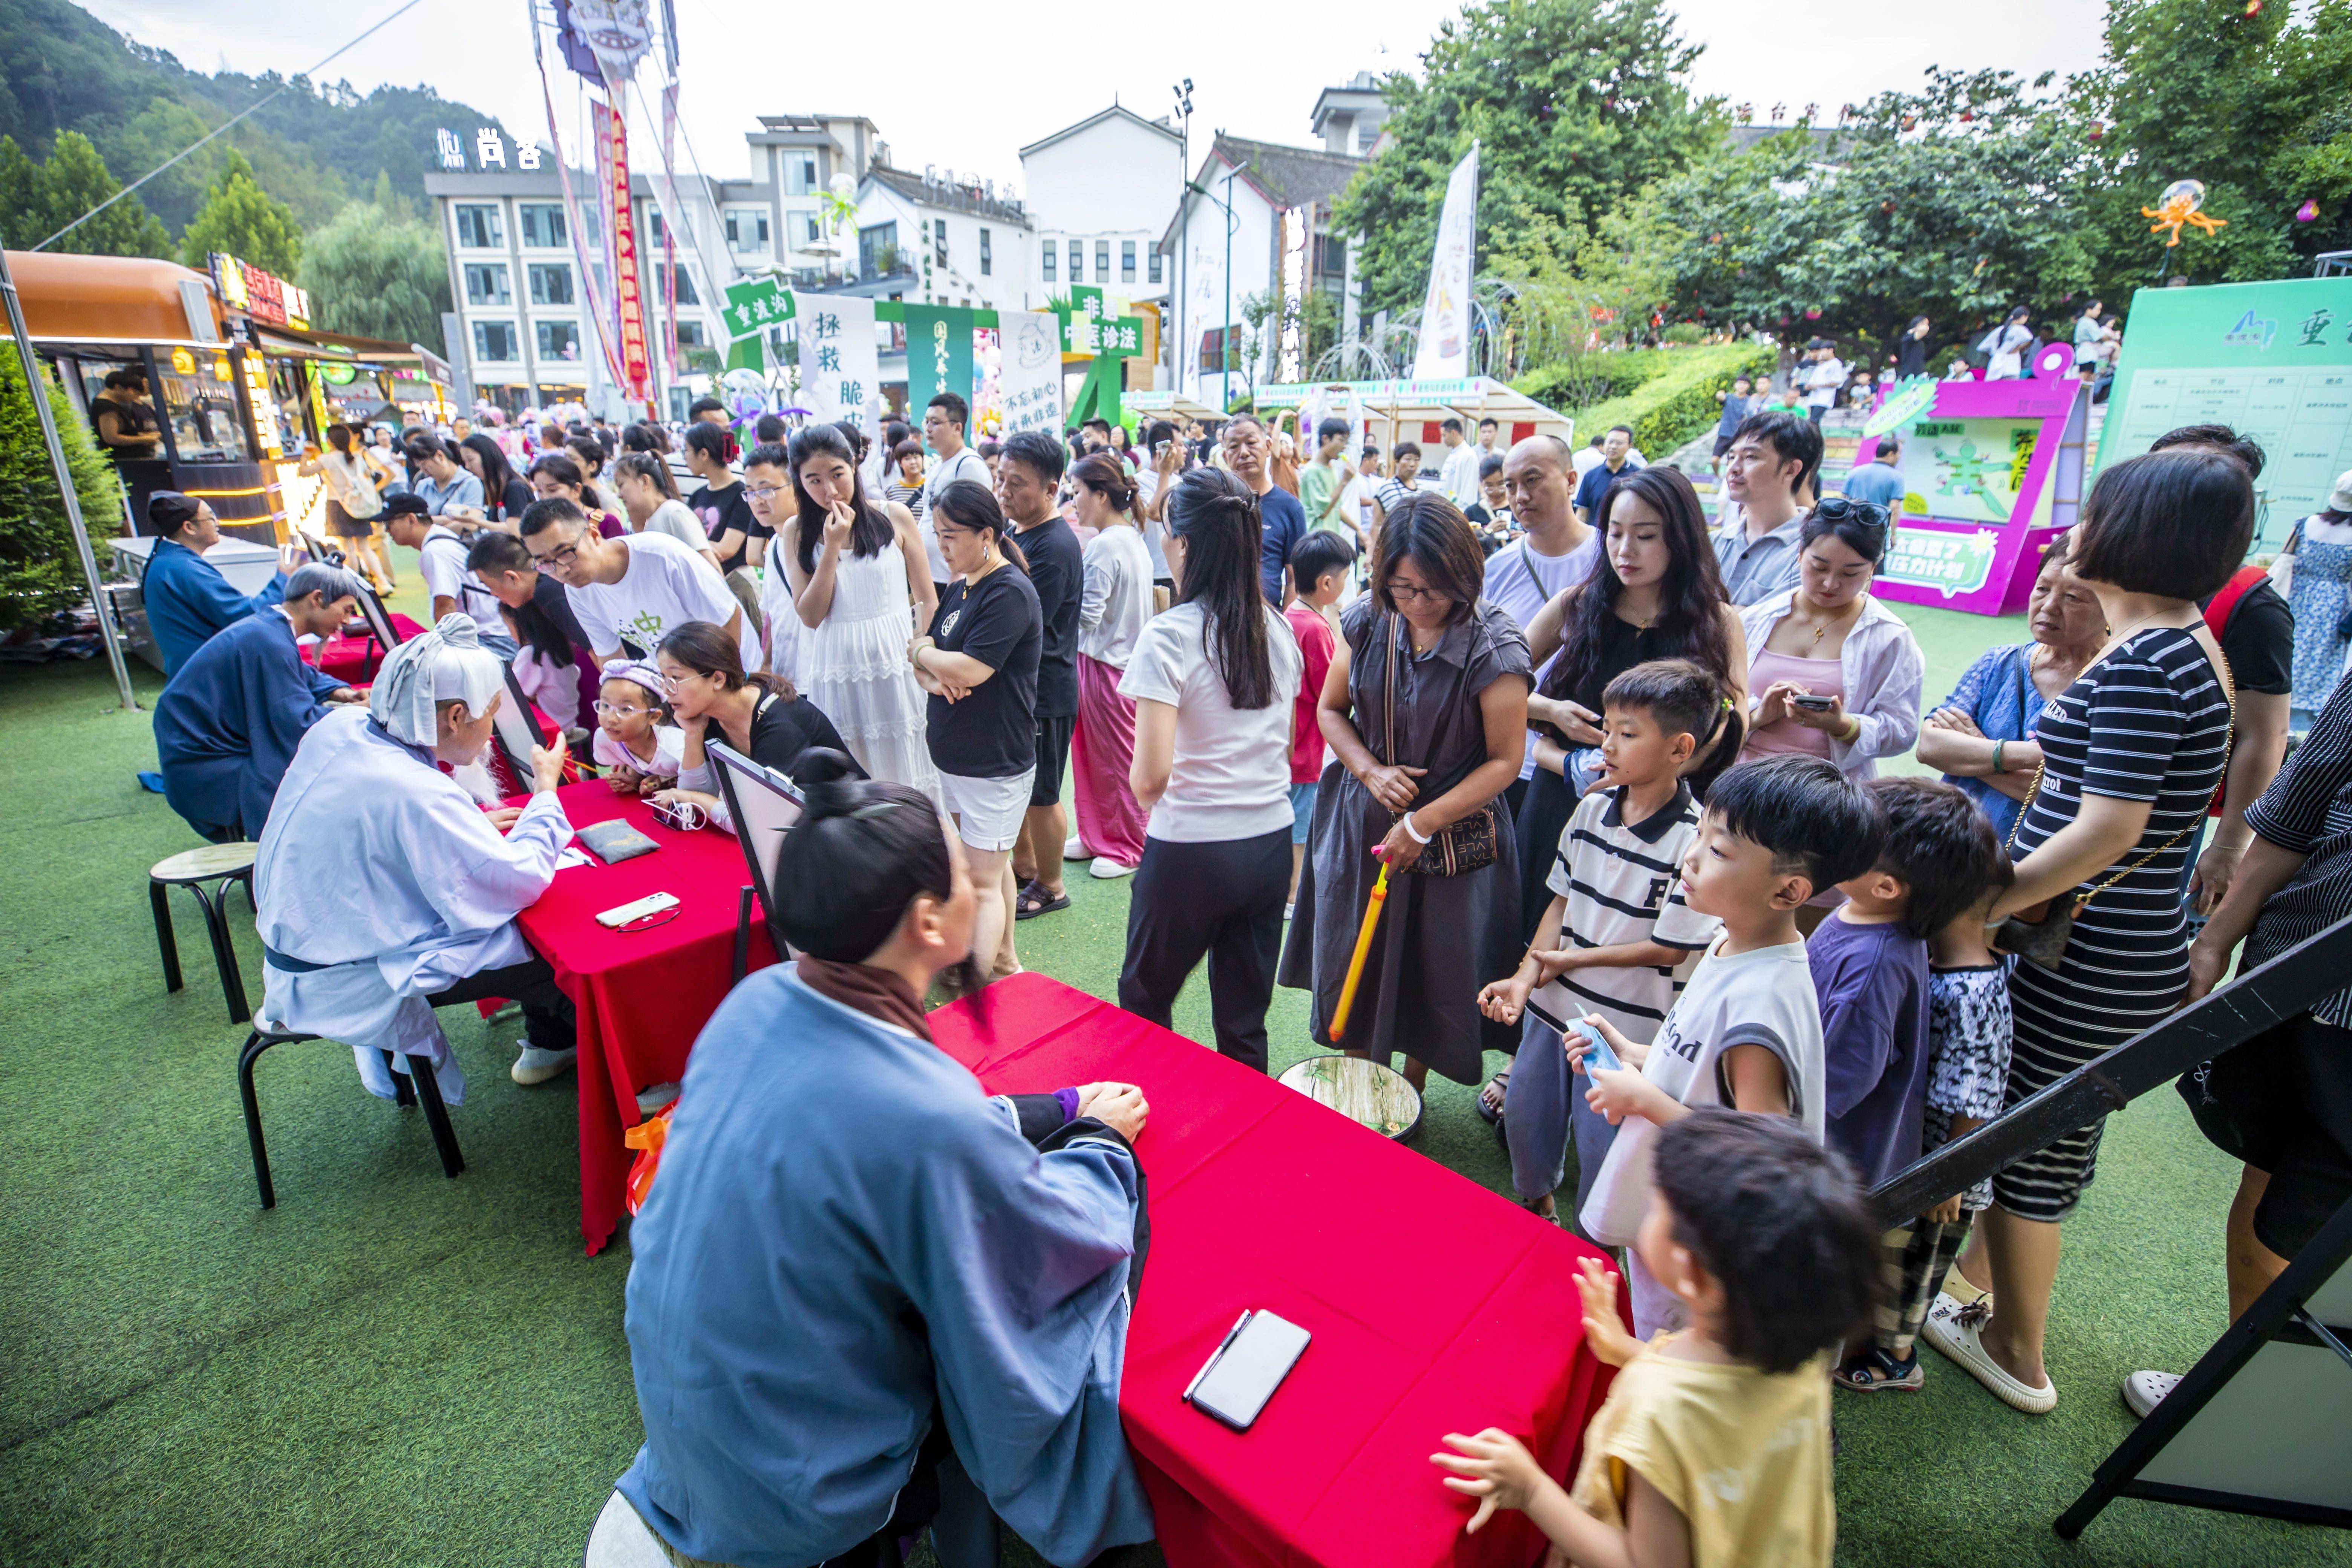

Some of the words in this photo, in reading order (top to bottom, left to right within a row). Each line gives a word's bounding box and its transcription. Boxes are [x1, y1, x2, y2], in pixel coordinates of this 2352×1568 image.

[734, 292, 789, 328] 重渡沟
[1082, 295, 1119, 322] 非遗
[815, 311, 841, 372] 拯救
[1064, 321, 1136, 350] 中医诊法
[2296, 309, 2352, 346] 重
[1005, 381, 1057, 411] 不忘初心
[1009, 401, 1061, 434] 传承非遗
